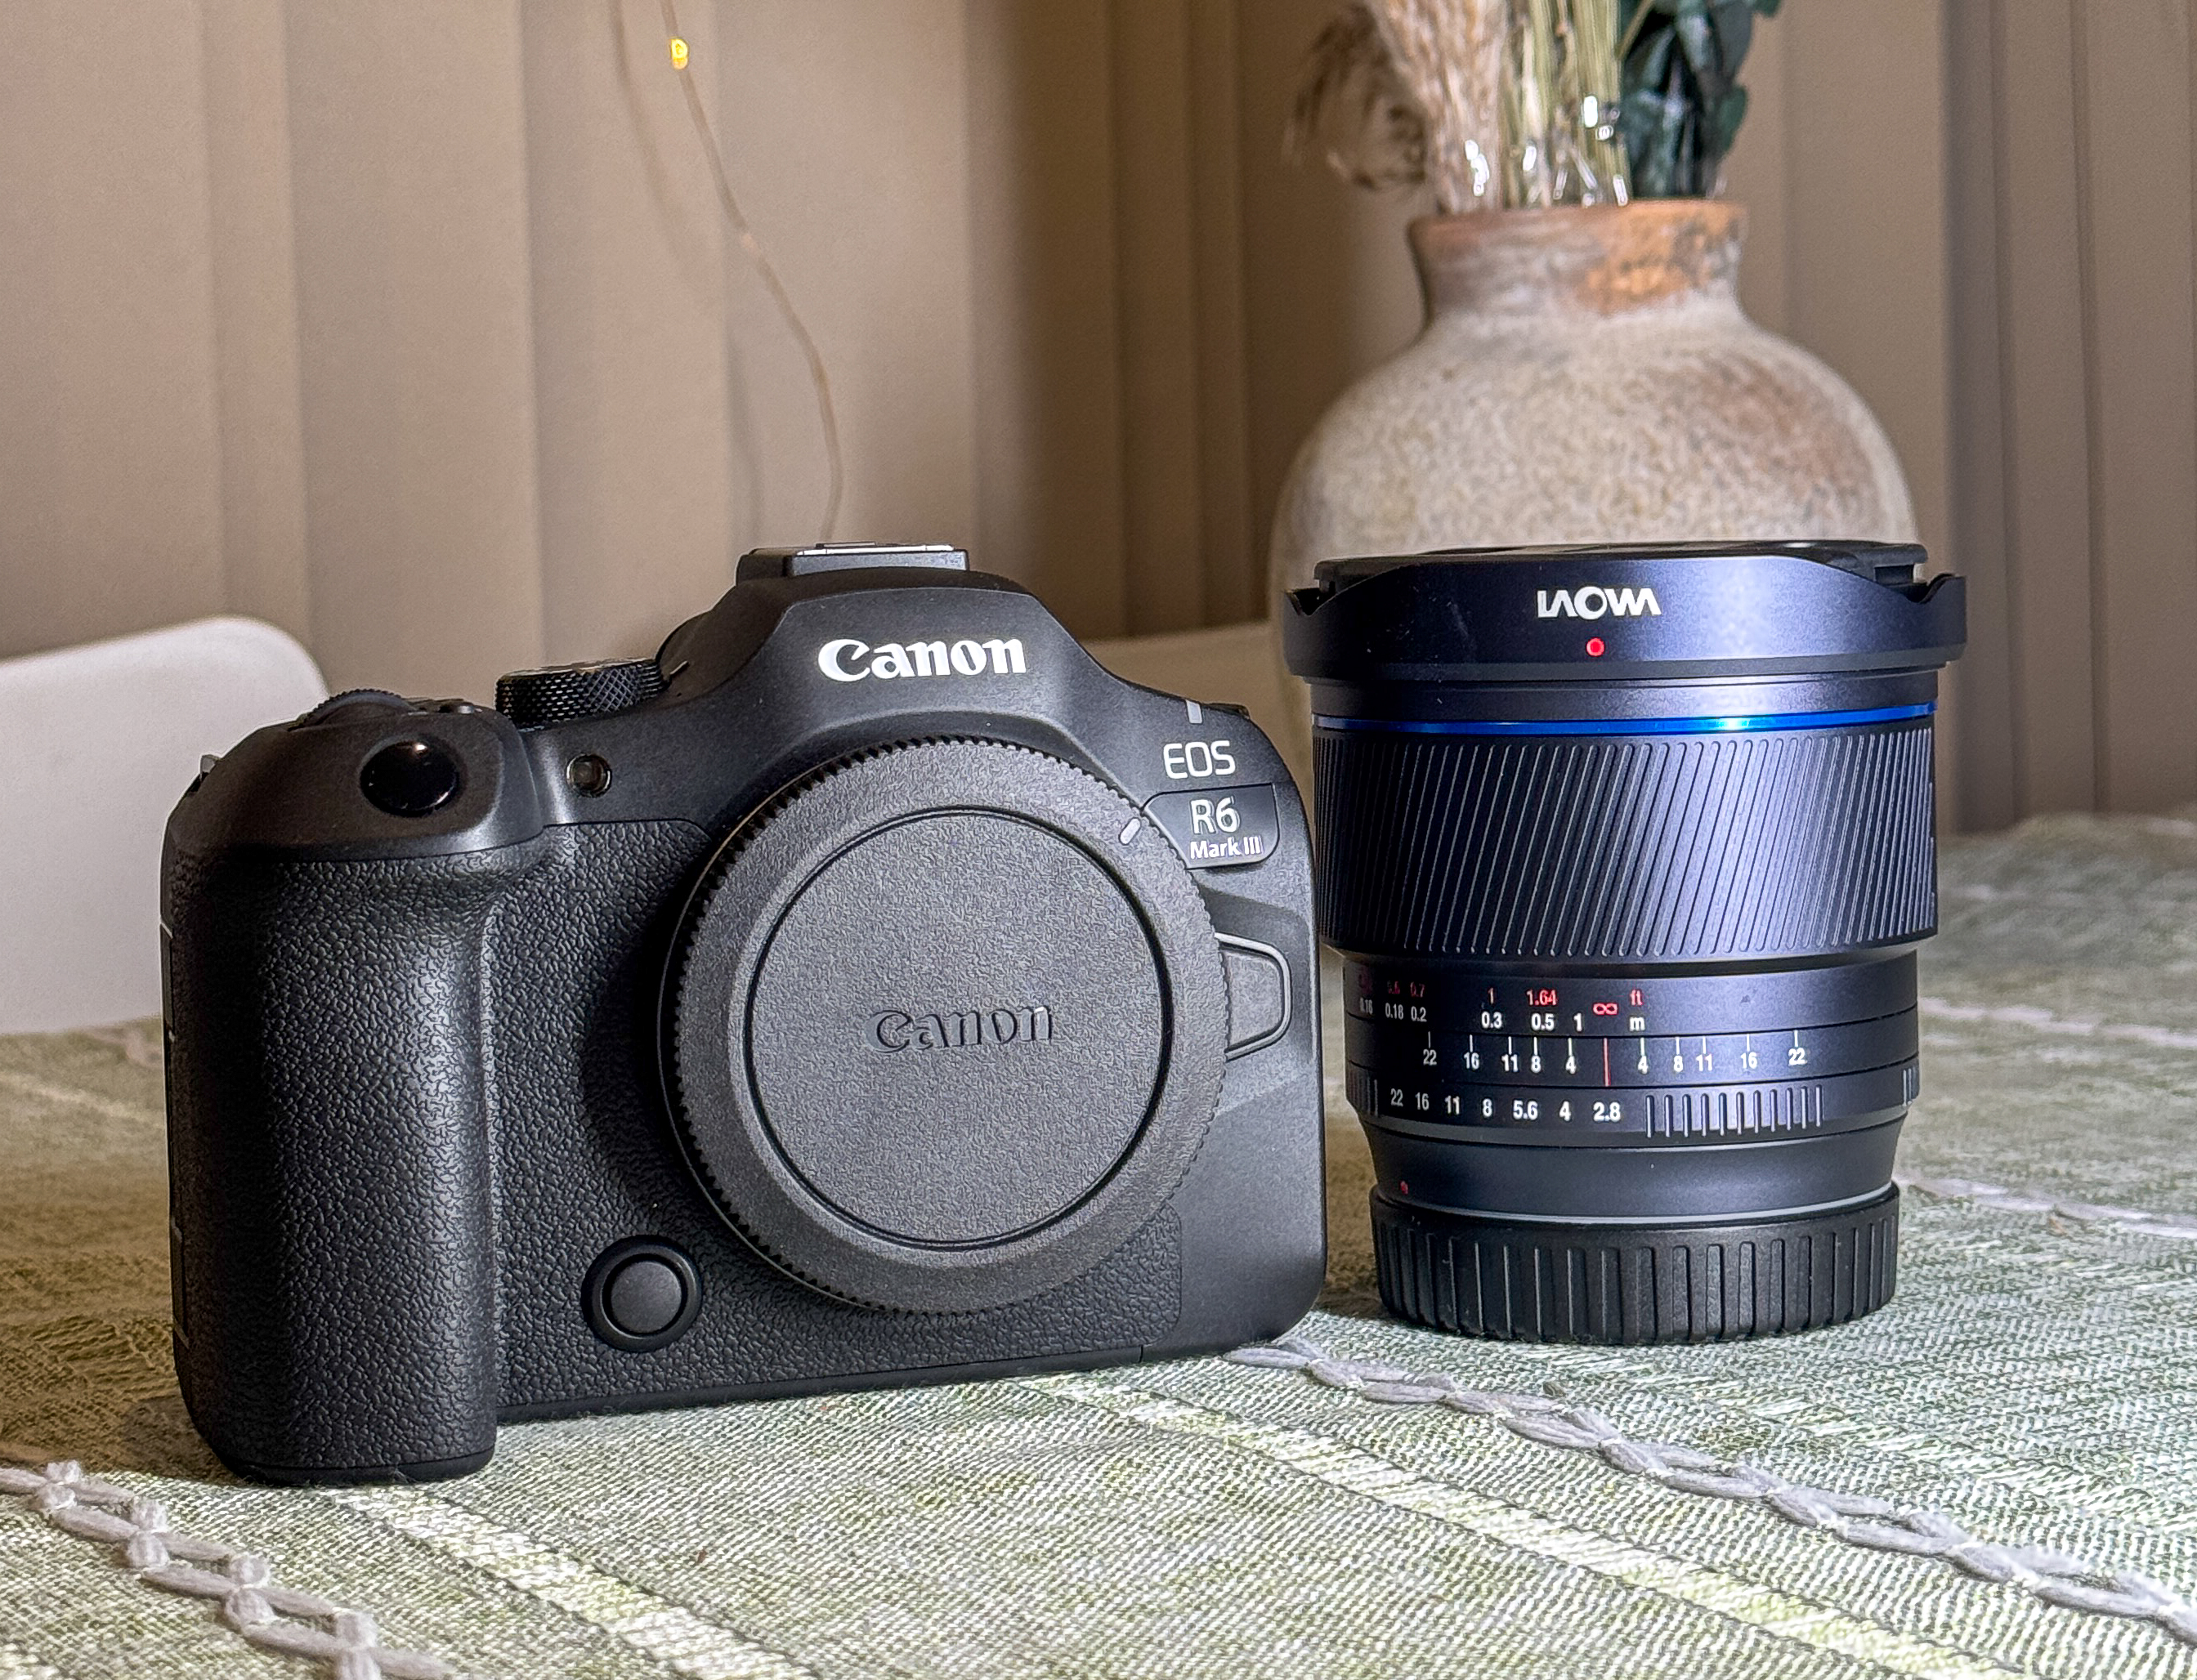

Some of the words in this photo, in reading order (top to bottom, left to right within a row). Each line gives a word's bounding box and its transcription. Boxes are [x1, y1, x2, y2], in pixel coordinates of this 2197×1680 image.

[1537, 586, 1662, 620] LAOWA
[817, 638, 1027, 682] Canon
[1163, 739, 1236, 780] EOS
[1190, 796, 1241, 835] R6
[1190, 838, 1242, 859] Mark
[1243, 835, 1264, 856] III
[1488, 987, 1496, 1004] 1
[1527, 989, 1557, 1006] 1.64
[1630, 989, 1643, 1006] ft
[864, 1006, 1053, 1054] Canon
[1385, 1003, 1404, 1021] 0.18
[1411, 1006, 1427, 1022] 0.2
[1481, 1011, 1502, 1029] 0.3
[1531, 1012, 1554, 1031] 0.5
[1573, 1013, 1583, 1032] 1
[1629, 1016, 1645, 1031] m
[1423, 1049, 1437, 1066] 22
[1464, 1052, 1479, 1070] 16
[1501, 1055, 1518, 1073] 11
[1531, 1055, 1541, 1073] 8
[1565, 1056, 1576, 1075] 4
[1637, 1057, 1649, 1075] 4
[1673, 1055, 1684, 1072] 8
[1696, 1054, 1713, 1071] 11
[1741, 1052, 1757, 1070] 16
[1788, 1048, 1808, 1066] 22
[1390, 1089, 1403, 1106] 22
[1416, 1093, 1430, 1110] 16
[1445, 1097, 1460, 1115] 11
[1482, 1099, 1492, 1118] 8
[1513, 1101, 1538, 1120] 5.6
[1559, 1101, 1571, 1121] 4
[1593, 1102, 1621, 1122] 2.8
